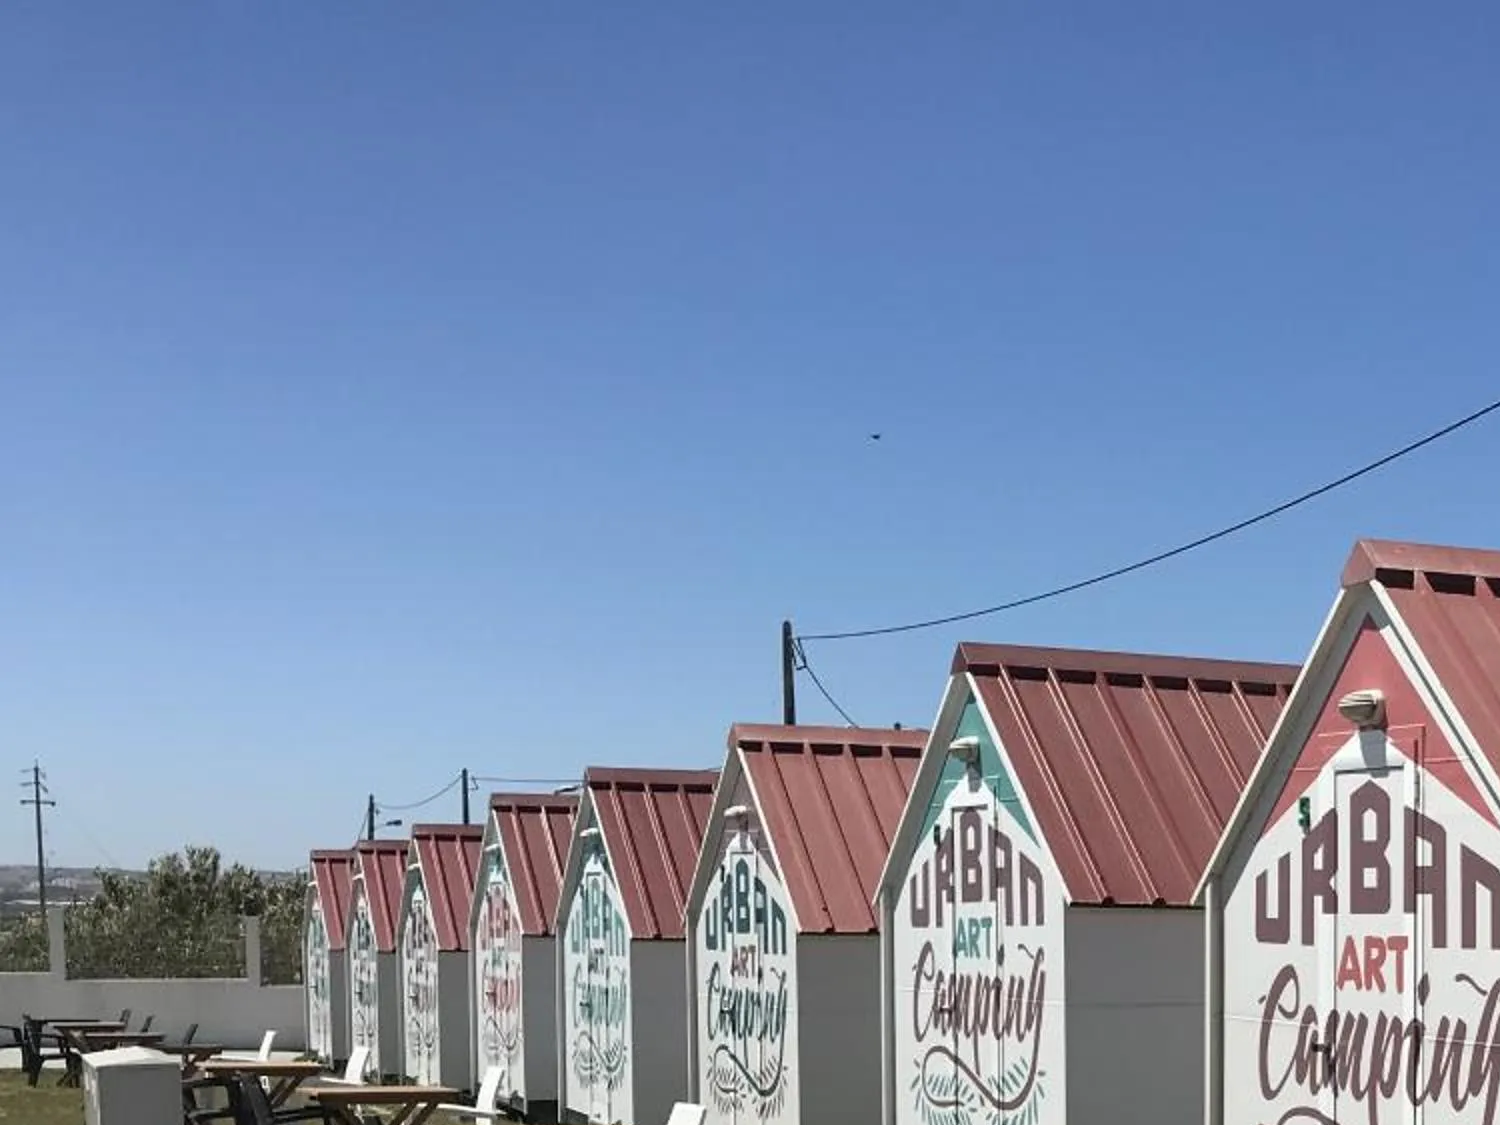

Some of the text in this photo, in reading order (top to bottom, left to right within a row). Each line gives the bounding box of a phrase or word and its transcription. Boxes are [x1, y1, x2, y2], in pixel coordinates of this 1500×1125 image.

[910, 807, 1044, 927] URBAN
[706, 858, 786, 955] URBAN
[955, 917, 992, 960] ART
[731, 945, 757, 978] ART
[1337, 935, 1408, 992] ART
[912, 940, 1045, 1076] Camping
